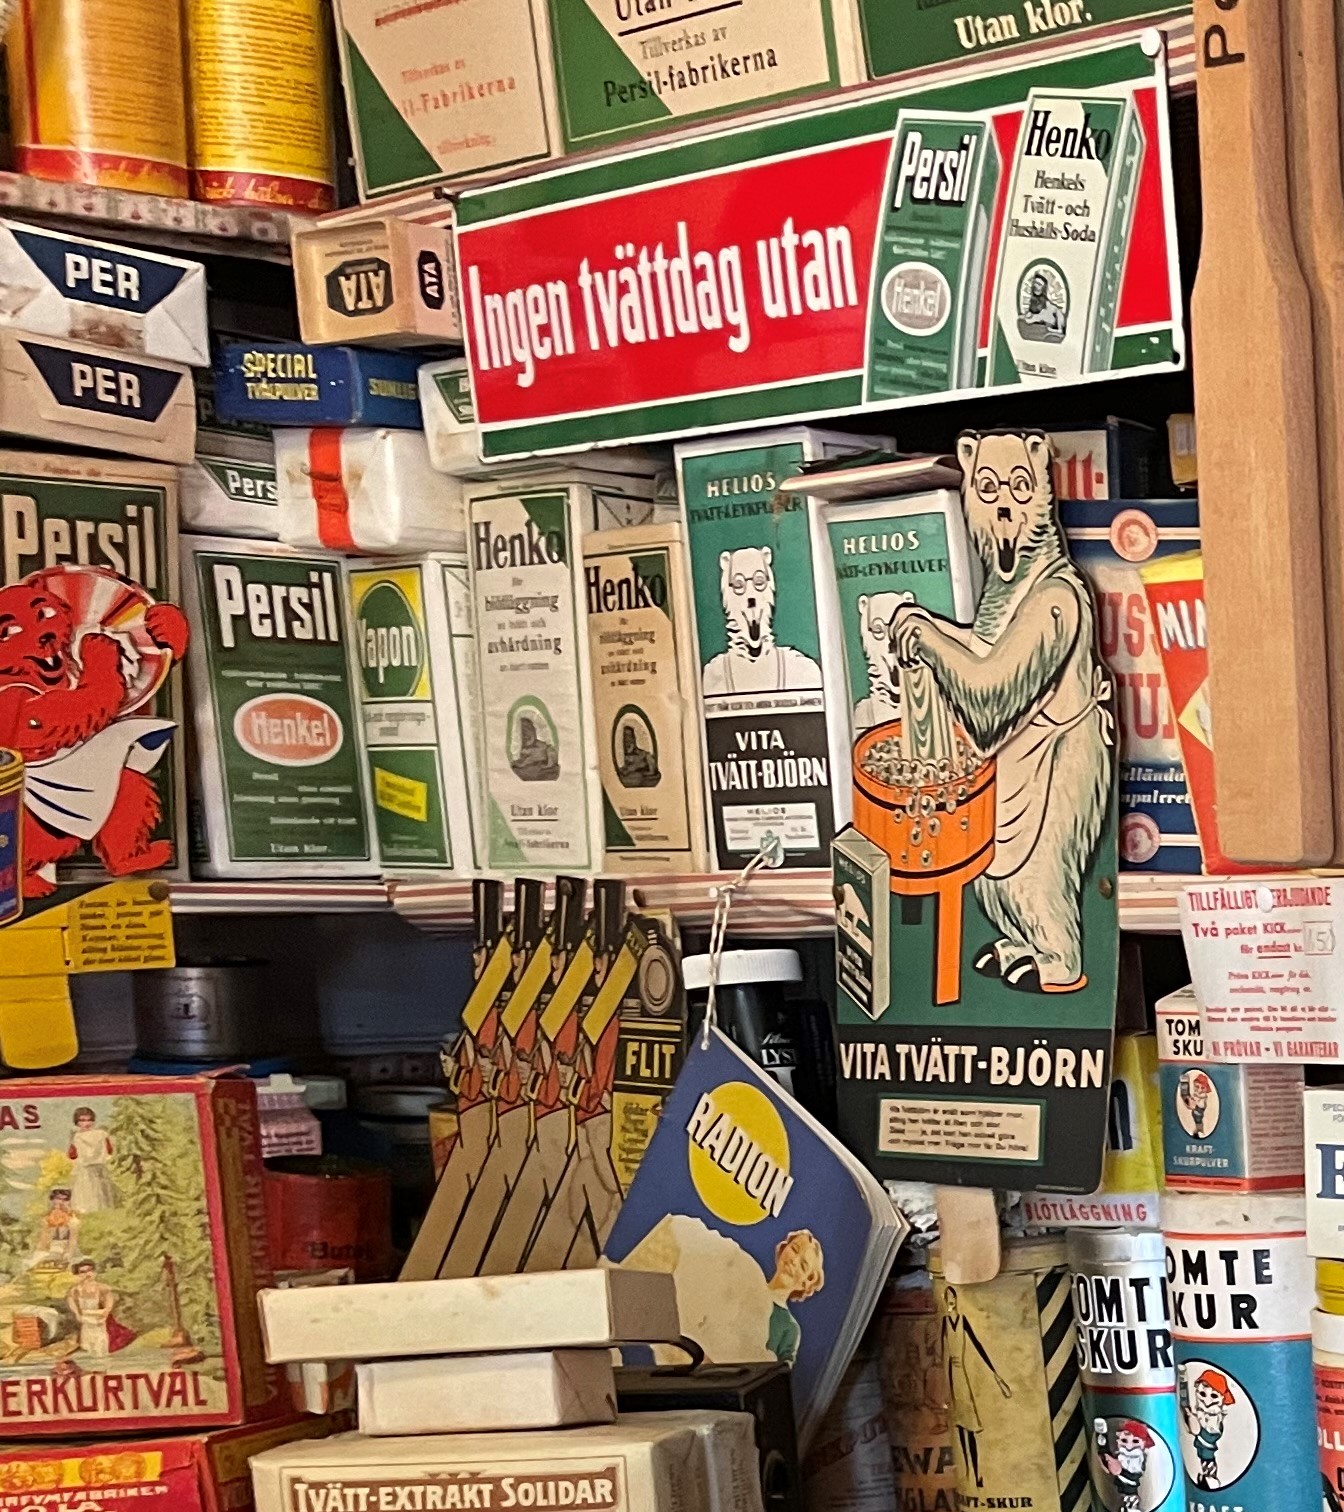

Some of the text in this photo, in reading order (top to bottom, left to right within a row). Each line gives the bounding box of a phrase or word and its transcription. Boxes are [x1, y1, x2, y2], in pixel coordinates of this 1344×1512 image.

[954, 15, 1020, 49] Utan
[1024, 110, 1112, 162] Henko
[893, 131, 977, 211] Persil
[64, 251, 141, 302] PER
[338, 270, 386, 311] ATA
[422, 262, 440, 298] ATA
[468, 216, 859, 388] Ingen tvättdag utan
[71, 361, 142, 408] PER
[242, 350, 317, 379] SPECIAL
[706, 471, 777, 498] HELIOS
[2, 494, 155, 590] Persil
[473, 520, 567, 571] Henko
[843, 530, 921, 556] HELIOS
[212, 564, 339, 649] Persil
[584, 565, 666, 616] Henko
[248, 710, 331, 748] Henkel
[735, 730, 785, 752] VITA
[709, 751, 829, 792] TVÄTT-BJÖRN
[1192, 921, 1257, 939] Två paket
[625, 1041, 676, 1079] FLIT
[839, 1036, 1105, 1089] VITA TVÄTT-BJÖRN
[685, 1091, 794, 1219] RADION
[1025, 1200, 1148, 1223] BLÖTLÄGGNING
[501, 1477, 614, 1508] SOLIDAR
